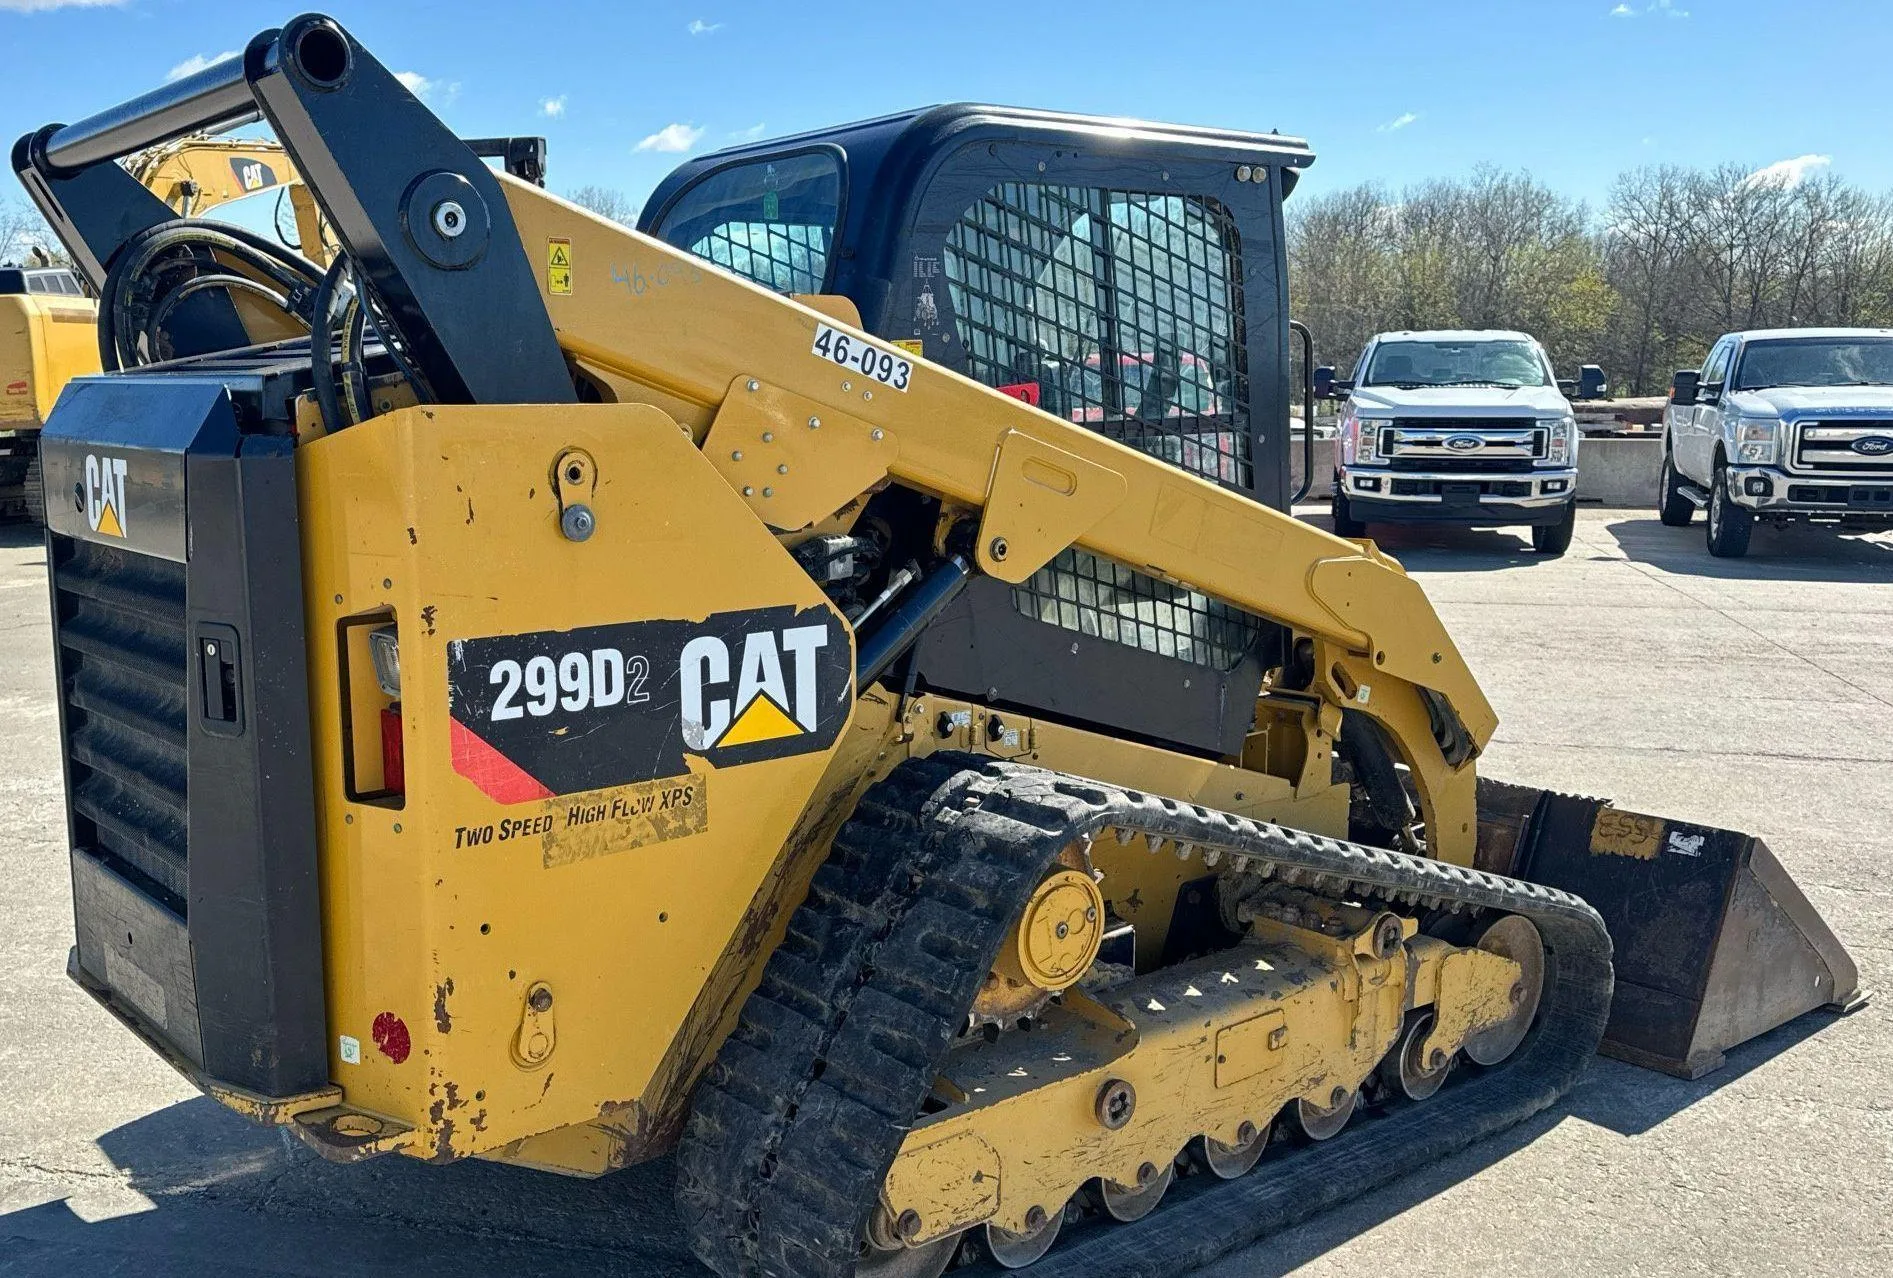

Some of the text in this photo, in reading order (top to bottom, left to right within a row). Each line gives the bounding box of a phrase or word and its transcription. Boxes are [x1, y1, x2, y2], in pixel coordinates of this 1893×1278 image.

[243, 163, 263, 190] CAT
[815, 328, 910, 390] 46-093
[1862, 441, 1888, 450] Ford
[85, 454, 128, 538] CAT
[680, 624, 828, 751] CAT
[659, 786, 694, 811] XPS
